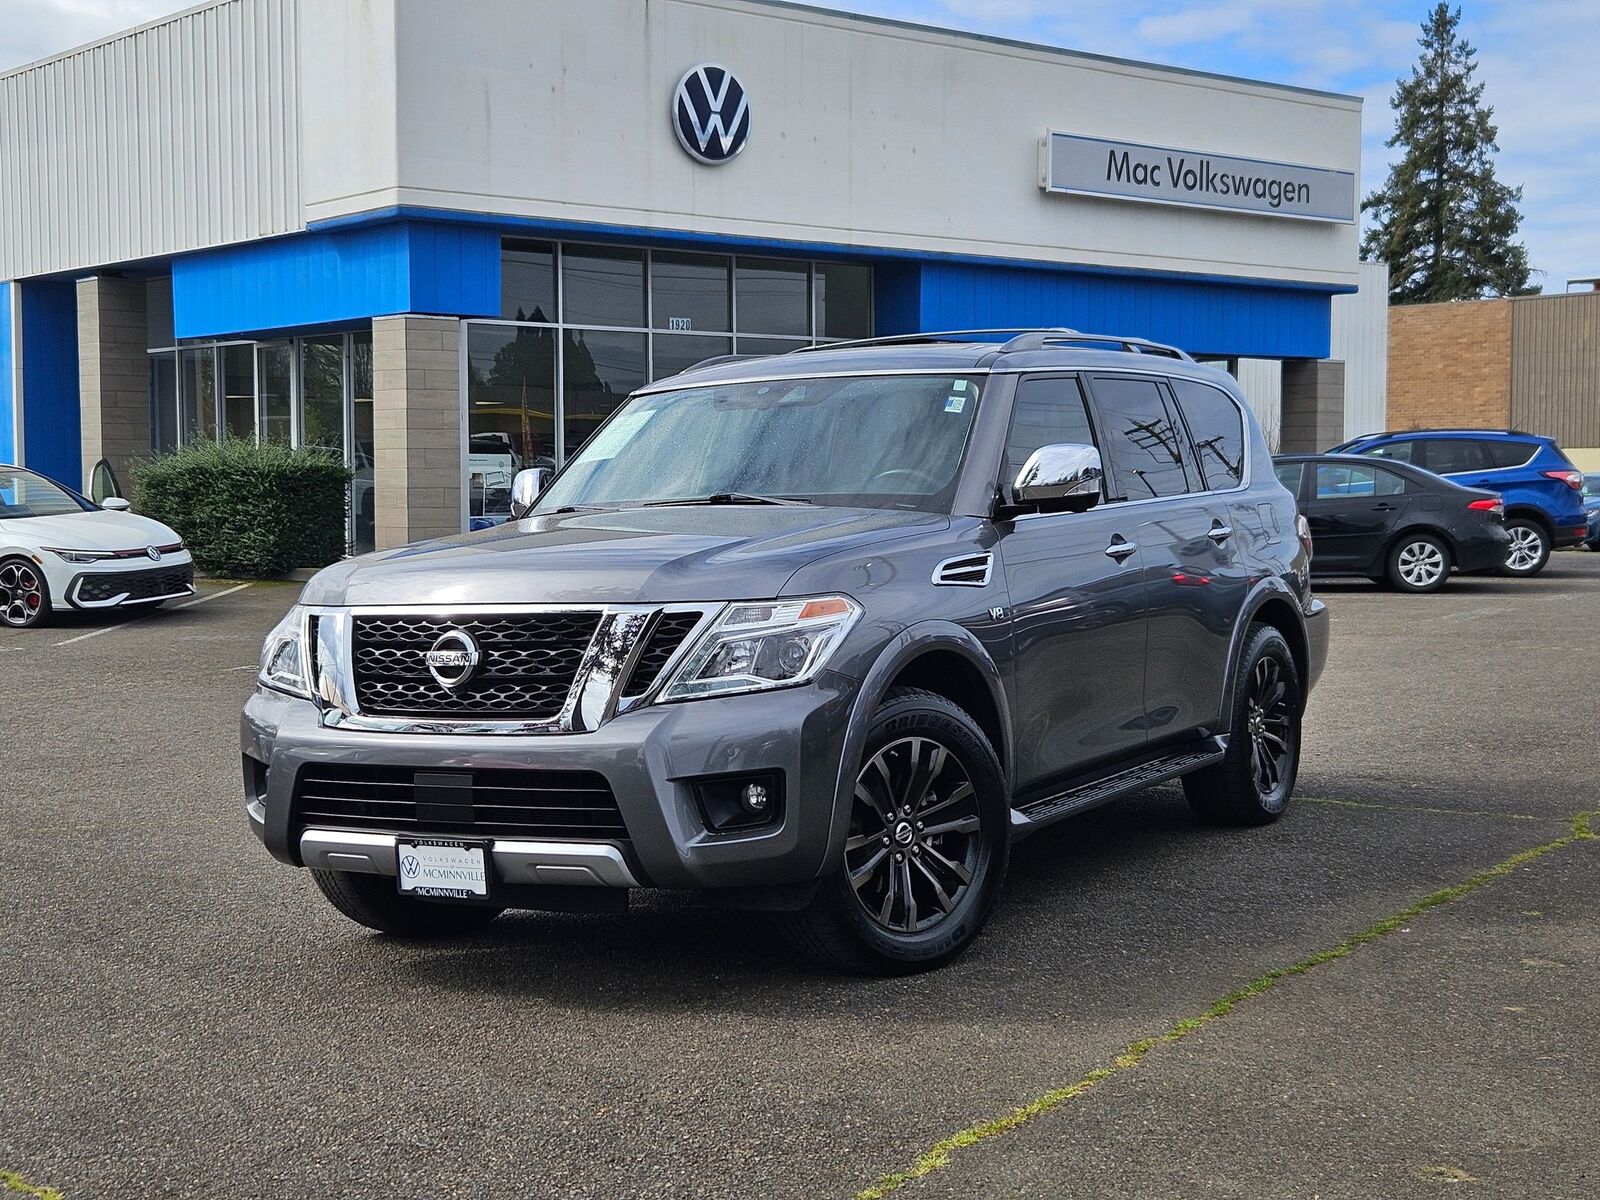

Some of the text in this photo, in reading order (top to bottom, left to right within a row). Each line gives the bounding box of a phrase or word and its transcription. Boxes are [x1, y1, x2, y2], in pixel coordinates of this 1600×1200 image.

[1106, 149, 1311, 208] Mac Volkswagen
[670, 319, 691, 330] 1920
[988, 606, 1004, 620] V8
[428, 653, 471, 663] NISSAN
[423, 856, 481, 865] VOLKSWAGEN
[423, 869, 485, 882] MCMINNVILLE
